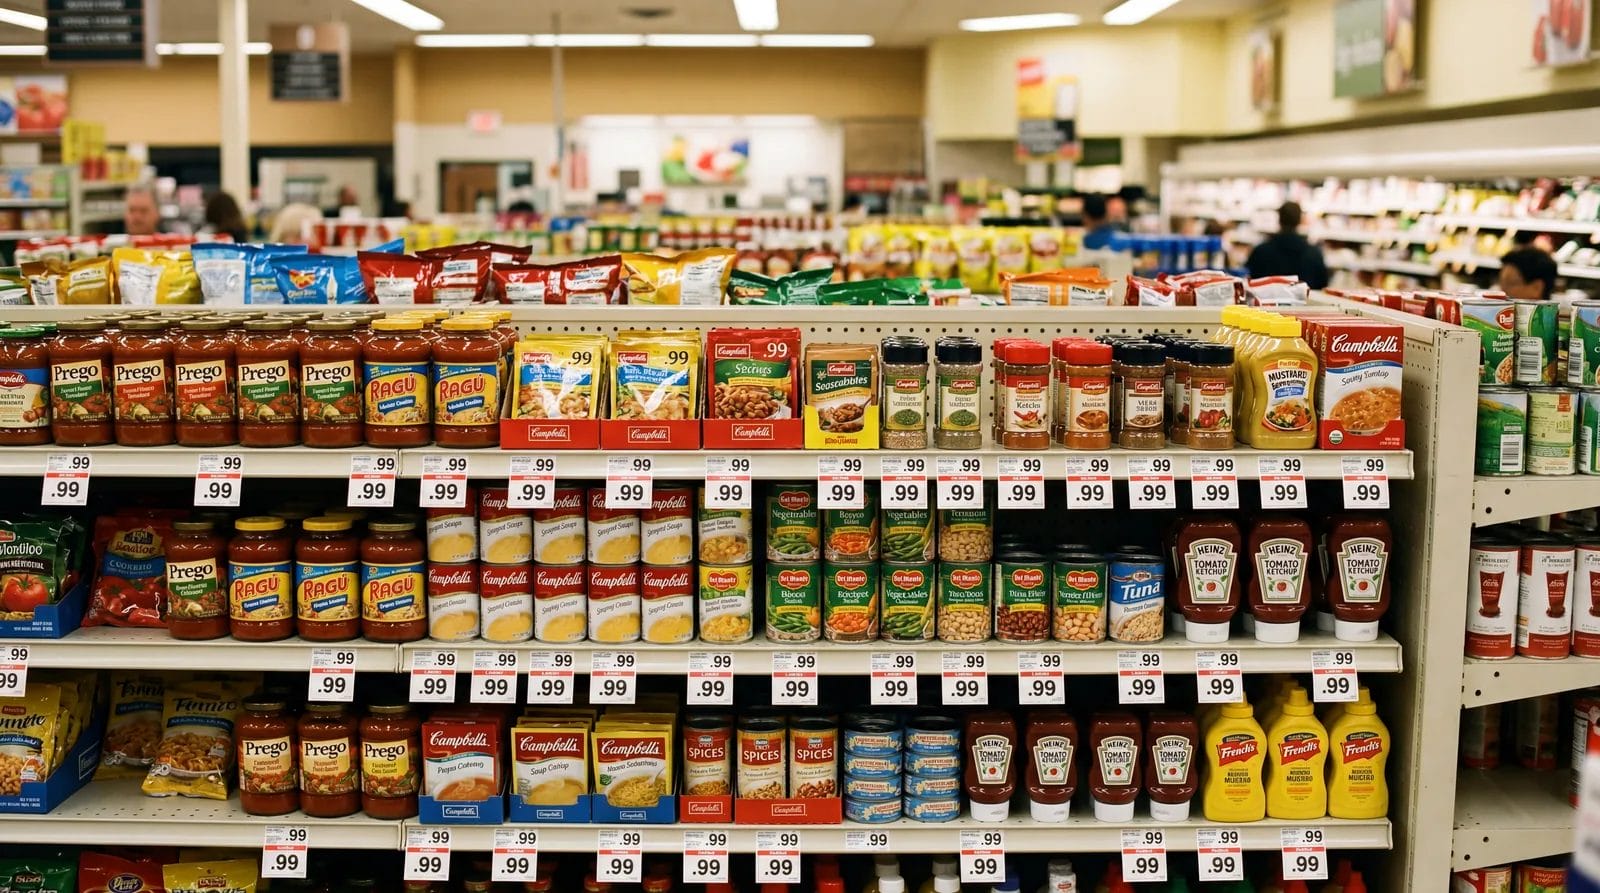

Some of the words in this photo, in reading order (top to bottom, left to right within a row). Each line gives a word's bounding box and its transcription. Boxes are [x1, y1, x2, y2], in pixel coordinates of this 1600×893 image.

[664, 350, 689, 365] .99
[763, 342, 788, 358] .99
[568, 351, 592, 365] .99
[54, 363, 99, 383] Prego
[115, 363, 161, 383] Prego
[177, 364, 223, 383] Prego
[239, 364, 284, 384] Prego
[303, 364, 350, 384] Prego
[68, 456, 90, 469] .99
[220, 456, 242, 470] .99
[373, 457, 395, 471] .99
[445, 458, 467, 471] .99
[532, 458, 554, 472] .99
[629, 458, 651, 471] .99
[728, 458, 750, 472] .99
[840, 458, 862, 472] .99
[903, 458, 925, 472] .99
[958, 458, 980, 472] .99
[1019, 458, 1041, 472] .99
[1087, 459, 1109, 472] .99
[1149, 459, 1171, 472] .99
[1212, 458, 1234, 472] .99
[1279, 458, 1301, 472] .99
[1362, 458, 1384, 472] .99
[51, 481, 80, 498] .99
[203, 482, 232, 499] .99
[357, 482, 386, 500] .99
[429, 483, 458, 500] .99
[517, 484, 546, 501] .99
[615, 484, 644, 501] .99
[714, 484, 743, 501] .99
[826, 484, 855, 501] .99
[890, 484, 919, 501] .99
[946, 484, 975, 501] .99
[1007, 484, 1036, 501] .99
[1076, 484, 1104, 501] .99
[1138, 484, 1167, 501] .99
[1201, 484, 1230, 501] .99
[1270, 484, 1298, 501] .99
[1352, 484, 1381, 501] .99
[1197, 545, 1225, 555] HEINZ
[1268, 545, 1296, 555] HEINZ
[1350, 544, 1378, 554] HEINZ
[1194, 560, 1227, 568] TOMATO
[1264, 560, 1298, 568] TOMATO
[1347, 559, 1380, 568] TOMATO
[169, 564, 213, 585] Prego
[1121, 581, 1161, 601] Tuna
[6, 648, 28, 661] .99
[333, 651, 355, 665] .99
[434, 653, 456, 666] .99
[494, 653, 516, 667] .99
[551, 654, 573, 667] .99
[613, 654, 635, 667] .99
[709, 655, 731, 668] .99
[793, 655, 815, 668] .99
[892, 655, 914, 668] .99
[963, 655, 985, 668] .99
[1039, 654, 1061, 668] .99
[1138, 653, 1160, 667] .99
[1216, 653, 1238, 666] .99
[1331, 652, 1353, 665] .99
[318, 676, 346, 694] .99
[419, 678, 447, 695] .99
[480, 678, 508, 696] .99
[536, 679, 565, 696] .99
[599, 679, 627, 696] .99
[697, 680, 725, 697] .99
[781, 680, 809, 698] .99
[880, 680, 908, 697] .99
[951, 680, 979, 697] .99
[1028, 679, 1056, 697] .99
[1128, 678, 1156, 696] .99
[1207, 678, 1234, 695] .99
[1322, 677, 1350, 694] .99
[245, 739, 289, 760] Prego
[305, 742, 347, 762] Prego
[364, 743, 406, 763] Prego
[689, 747, 724, 759] SPICES
[743, 750, 780, 761] SPICES
[797, 749, 833, 760] SPICES
[1221, 745, 1256, 759] French's
[1283, 742, 1318, 758] French's
[1345, 741, 1380, 757] French's
[285, 828, 307, 842] .99
[428, 831, 450, 844] .99
[515, 832, 537, 845] .99
[619, 832, 641, 846] .99
[705, 833, 727, 846] .99
[776, 833, 798, 846] .99
[866, 833, 888, 846] .99
[980, 832, 1002, 846] .99
[1141, 831, 1163, 845] .99
[1217, 831, 1239, 844] .99
[1301, 830, 1323, 843] .99
[271, 854, 299, 871] .99
[414, 856, 442, 873] .99
[501, 857, 529, 874] .99
[606, 858, 634, 875] .99
[692, 859, 721, 876] .99
[765, 859, 793, 876] .99
[969, 858, 997, 875] .99
[1131, 857, 1159, 874] .99
[1208, 856, 1235, 873] .99
[1292, 855, 1319, 873] .99
